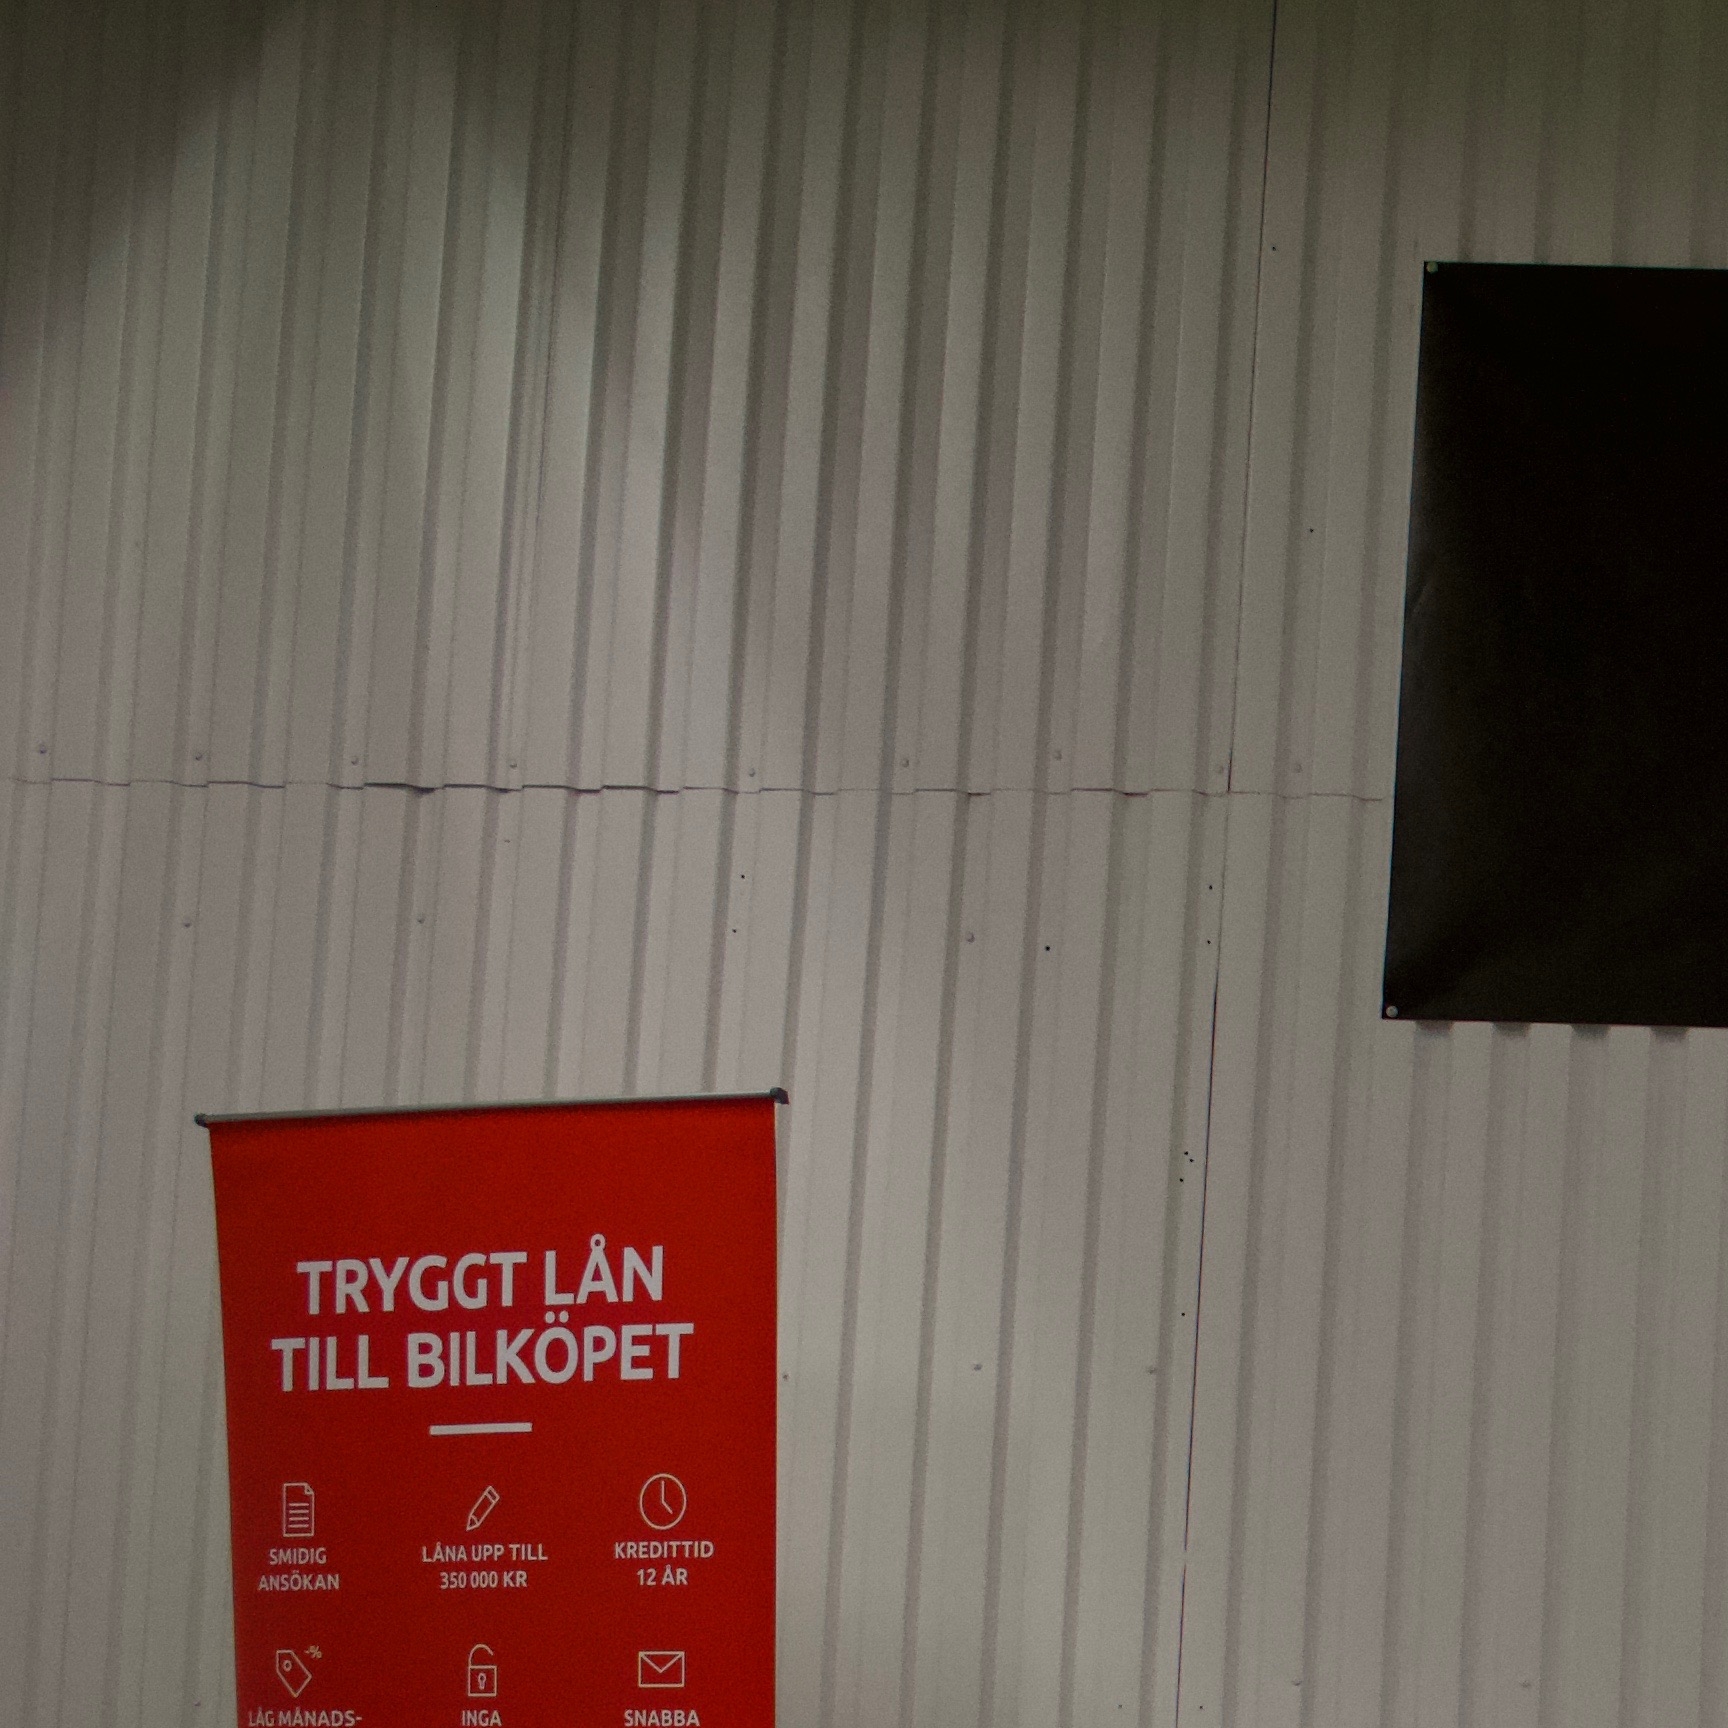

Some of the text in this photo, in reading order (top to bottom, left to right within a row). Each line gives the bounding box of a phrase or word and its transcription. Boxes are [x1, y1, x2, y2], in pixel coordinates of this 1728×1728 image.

[296, 1233, 664, 1315] TRYGGT LÅN
[270, 1310, 695, 1392] TILL BILKÖPET
[269, 1546, 327, 1566] SMIDIG
[421, 1541, 549, 1563] LÅNA UPP TILL
[614, 1540, 715, 1559] KREDITTID
[257, 1569, 340, 1592] ANSÖKAN
[502, 1570, 528, 1588] KR
[636, 1564, 688, 1586] 12 ÅR
[248, 1706, 363, 1728] LÅG MÅNADS-
[461, 1709, 502, 1727] INGA
[624, 1709, 701, 1727] SNABBA
